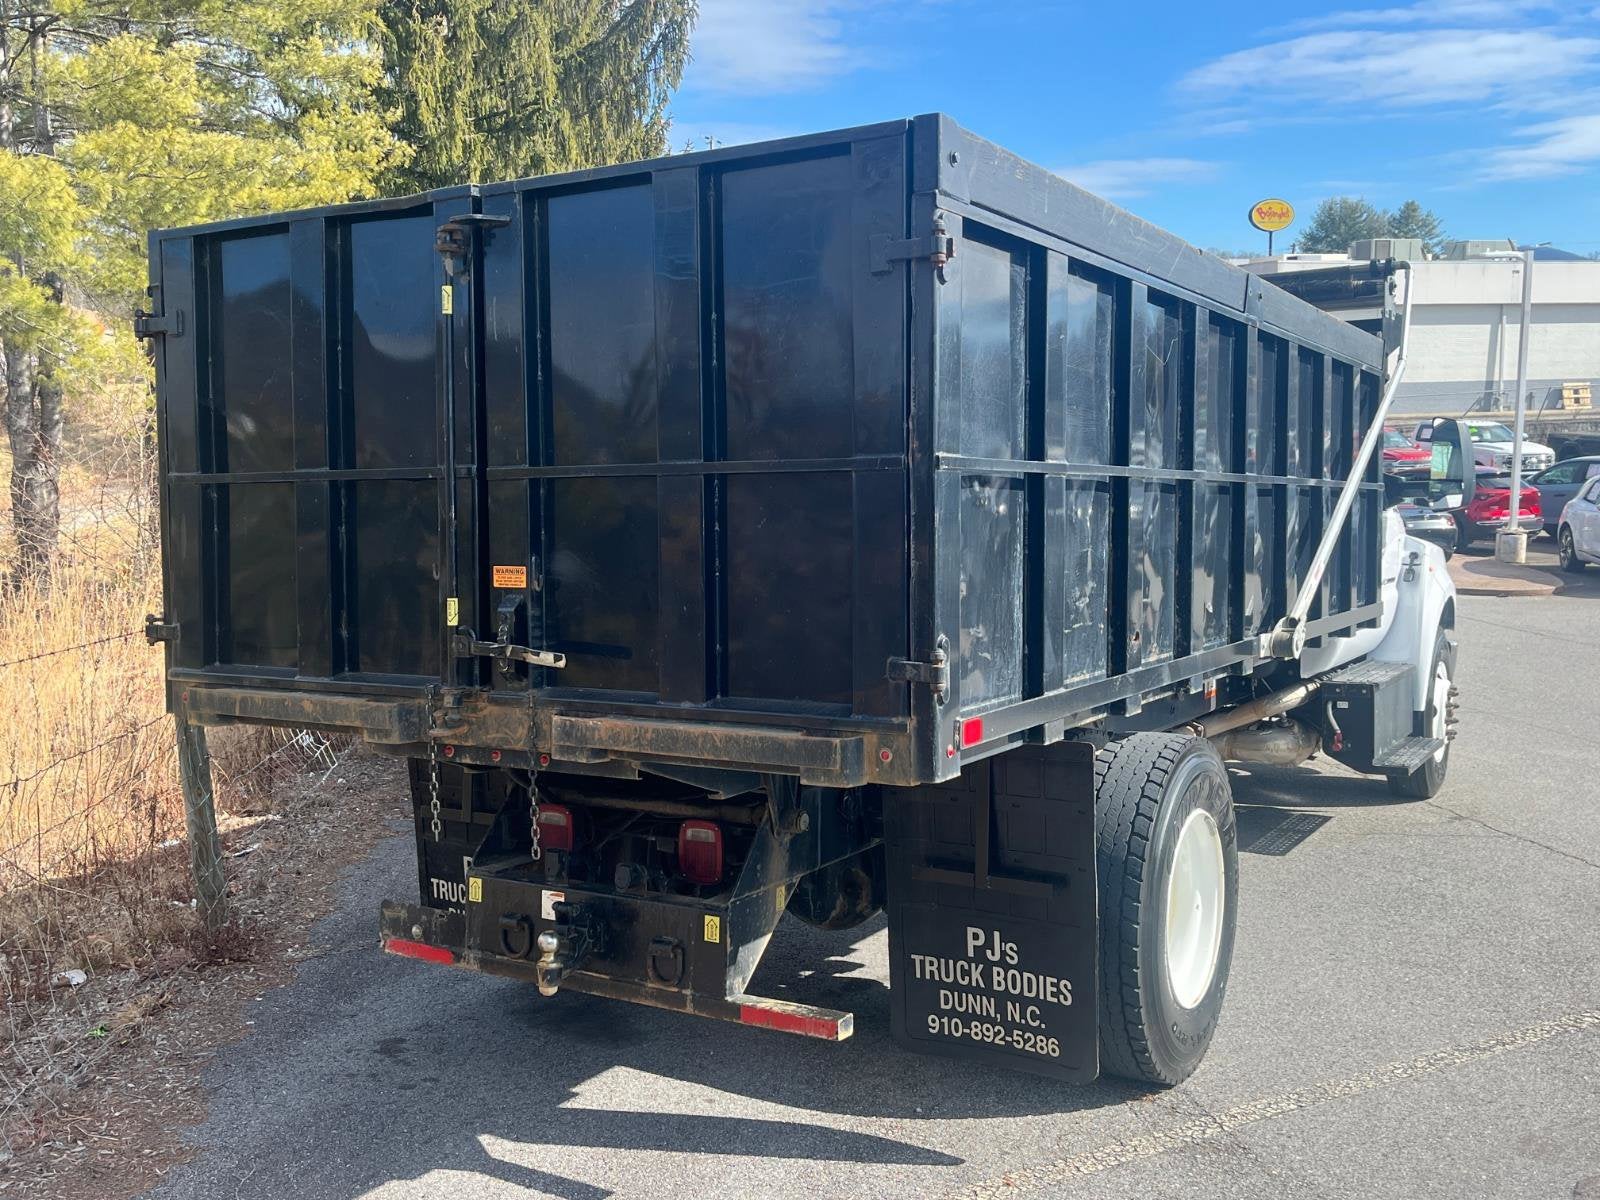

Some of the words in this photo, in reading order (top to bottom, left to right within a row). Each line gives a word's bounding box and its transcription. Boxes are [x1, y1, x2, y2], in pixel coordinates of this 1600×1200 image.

[430, 877, 467, 904] TRUC
[911, 953, 985, 989] TRUCK
[992, 966, 1073, 1007] BODIES
[940, 989, 1001, 1023] DUNN,
[1007, 1000, 1047, 1029] N.C.
[926, 1014, 1061, 1058] 910-892-5286
